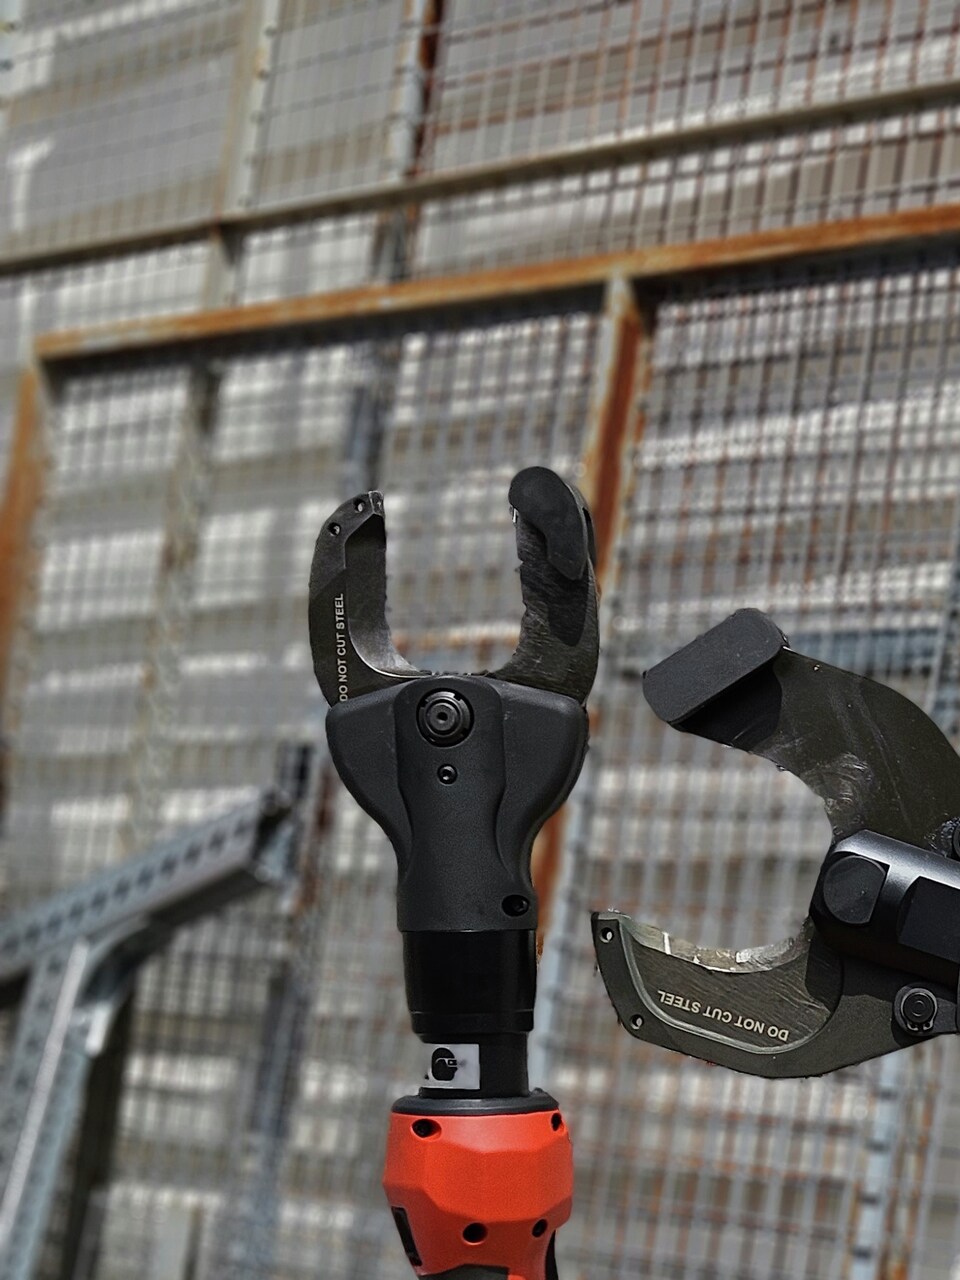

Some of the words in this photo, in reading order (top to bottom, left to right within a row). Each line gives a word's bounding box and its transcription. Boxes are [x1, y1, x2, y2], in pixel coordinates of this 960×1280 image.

[335, 593, 345, 630] STEEL
[336, 632, 347, 656] CUT
[337, 658, 348, 683] NOT
[339, 685, 349, 702] DO
[657, 990, 702, 1014] STEEL
[702, 1006, 733, 1023] CUT
[734, 1015, 765, 1034] NOT
[767, 1026, 790, 1042] DO
